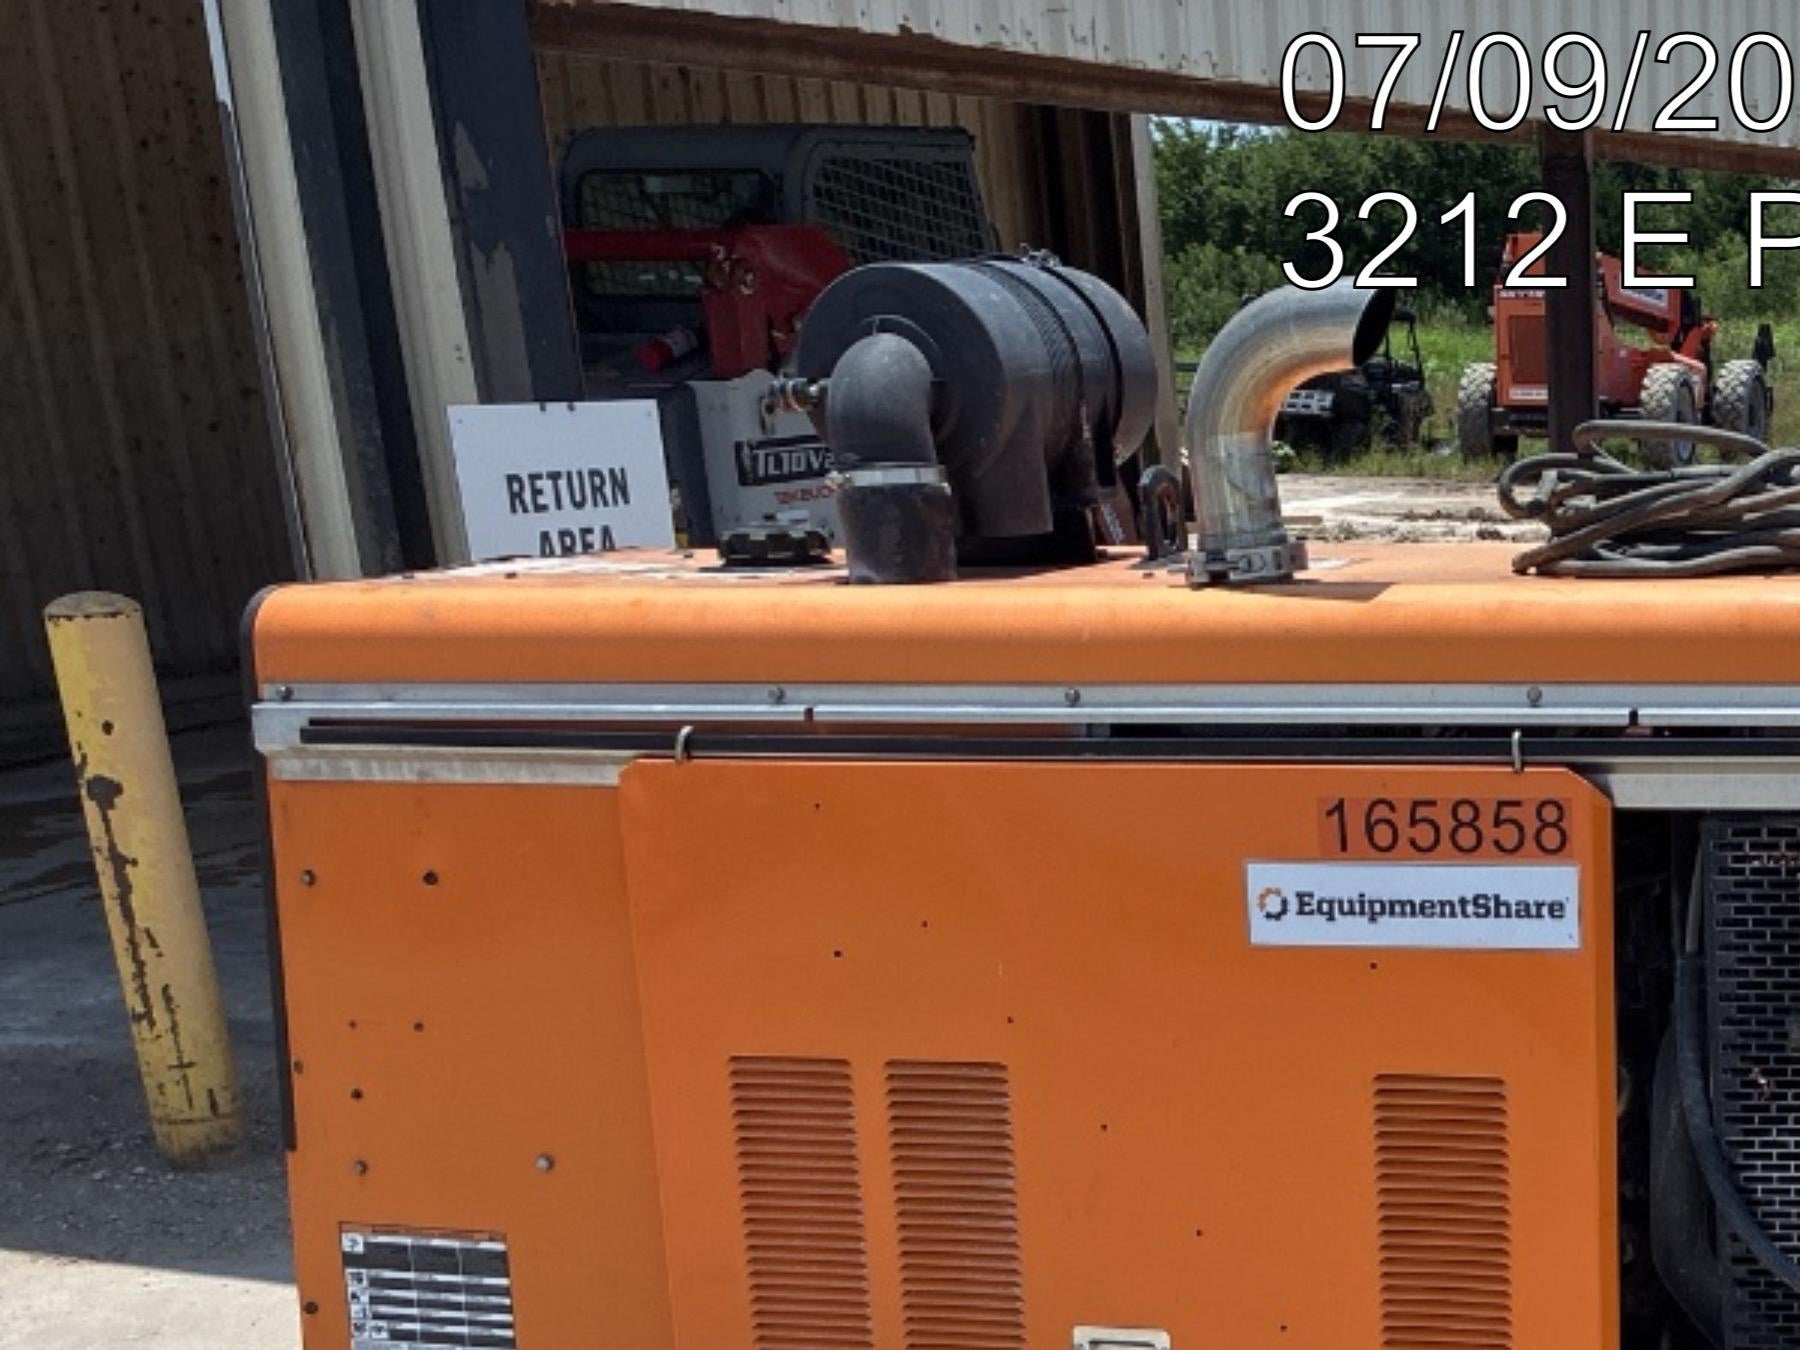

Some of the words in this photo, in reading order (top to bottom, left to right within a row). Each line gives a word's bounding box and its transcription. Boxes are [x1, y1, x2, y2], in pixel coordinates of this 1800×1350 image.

[506, 467, 630, 514] RETURN
[539, 525, 616, 557] AREA
[1325, 796, 1568, 854] 165858
[1295, 892, 1567, 923] EquipmentShare
